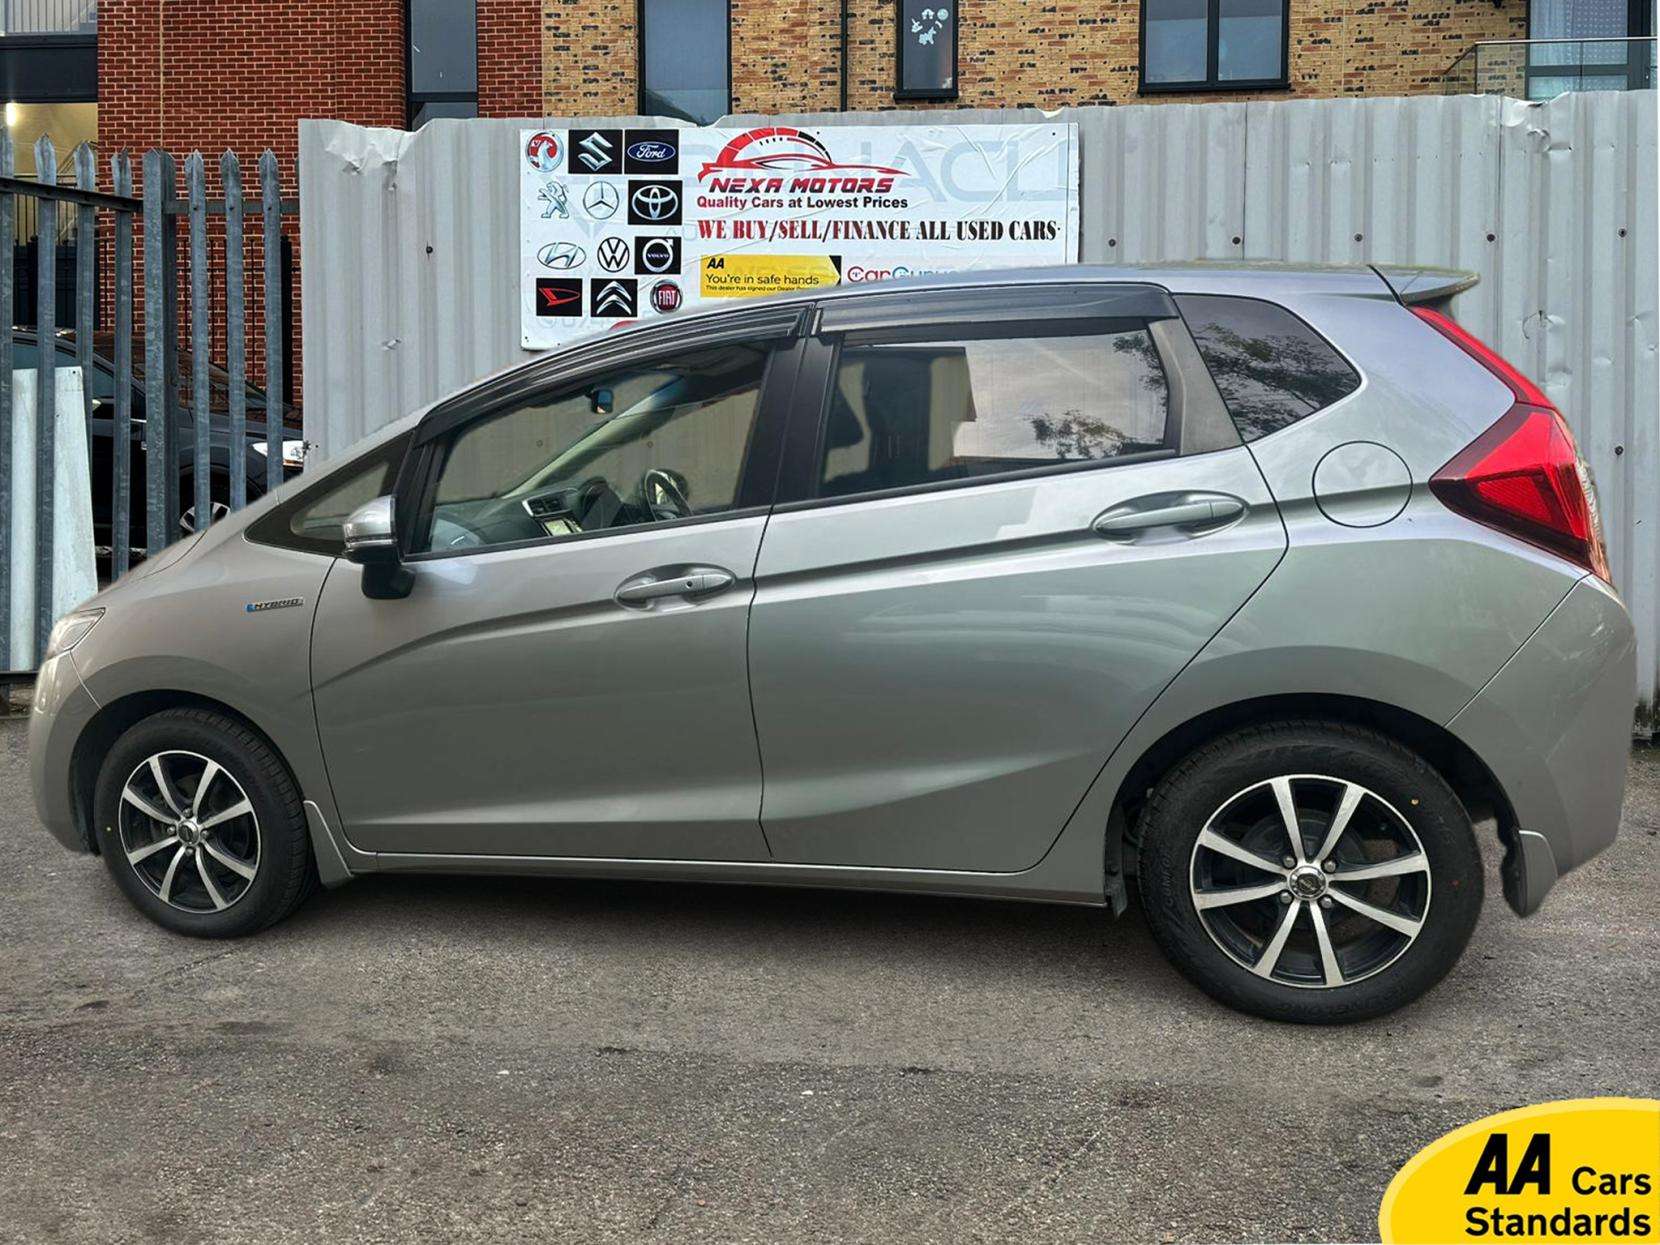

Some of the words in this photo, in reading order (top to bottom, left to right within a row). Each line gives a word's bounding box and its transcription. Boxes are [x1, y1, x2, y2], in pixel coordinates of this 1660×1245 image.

[636, 144, 666, 159] Ford
[709, 178, 784, 193] NEXA
[789, 178, 894, 193] MOTORS
[697, 195, 747, 211] Quality
[752, 196, 784, 208] Cars
[788, 197, 802, 208] at
[807, 196, 858, 208] Lowest
[863, 196, 908, 208] Prices
[697, 219, 726, 239] WE
[916, 220, 951, 240] ALL
[957, 220, 1004, 240] USED
[1009, 220, 1057, 240] CARS
[707, 258, 725, 269] AA
[705, 273, 741, 284] You're
[744, 274, 754, 284] in
[757, 273, 781, 285] safe
[784, 274, 820, 285] hands
[658, 289, 678, 306] FIAT
